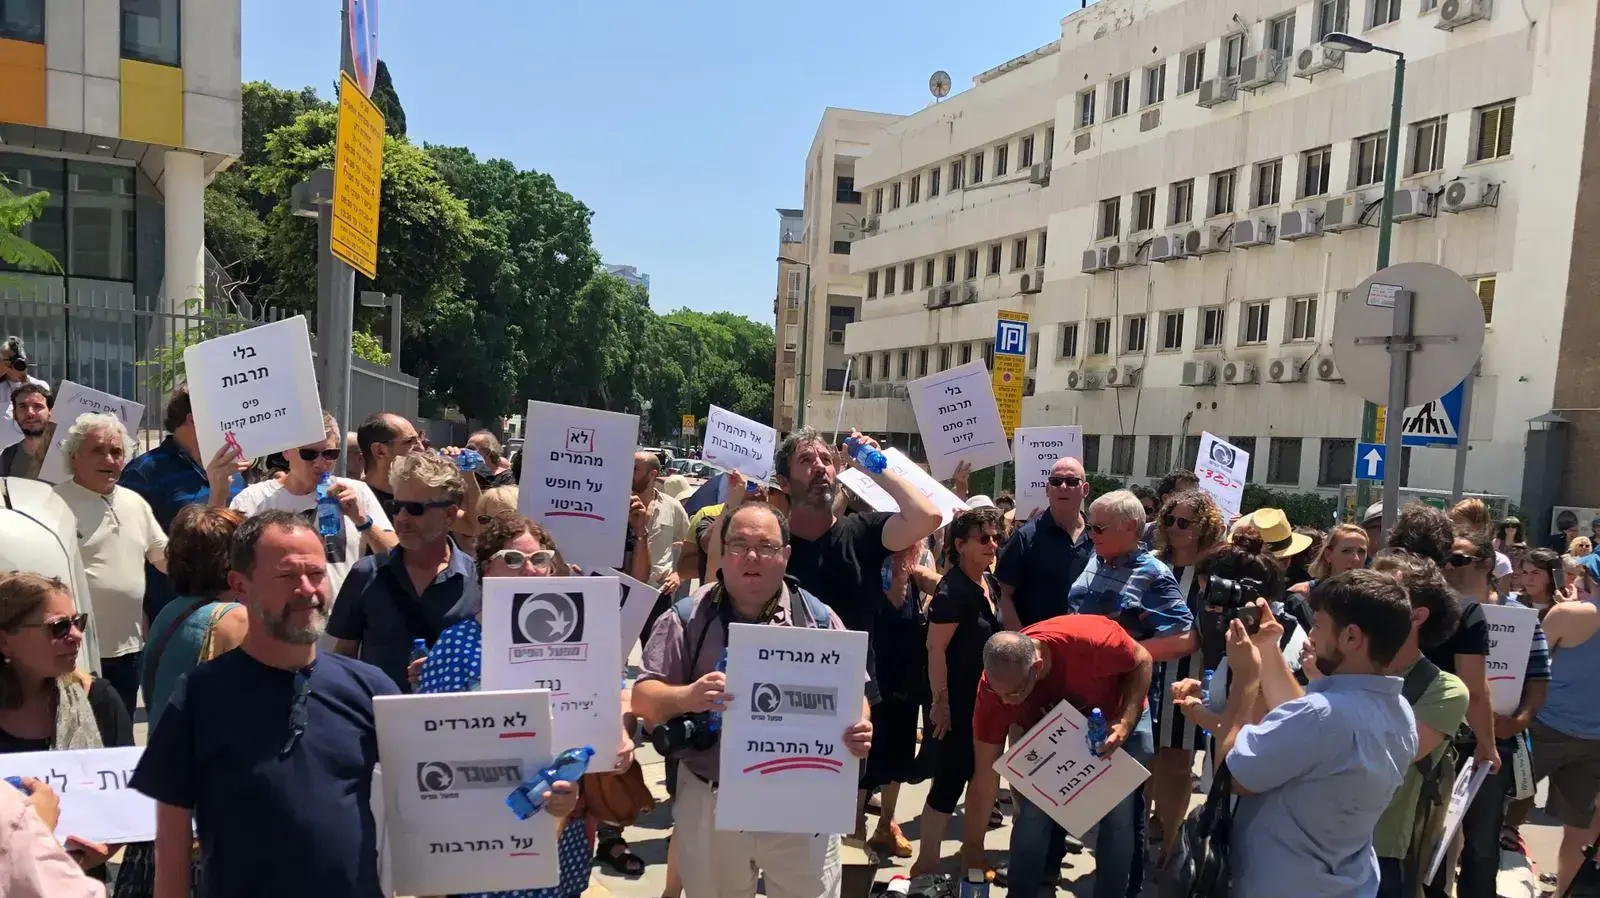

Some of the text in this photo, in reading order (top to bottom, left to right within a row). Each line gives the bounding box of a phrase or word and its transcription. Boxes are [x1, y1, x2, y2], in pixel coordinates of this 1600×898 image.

[232, 345, 257, 360] בלי
[222, 365, 269, 389] תרבות
[944, 385, 962, 395] בלי
[79, 397, 100, 409] תרצו
[242, 398, 260, 410] פיס
[939, 400, 972, 415] תרבות
[220, 408, 286, 431] זה סתם קזינו!
[943, 417, 977, 432] זה סתם
[570, 432, 588, 444] לא
[717, 421, 761, 444] אל תהמרו
[953, 433, 974, 444] קזינו
[711, 436, 762, 460] על התרבות
[550, 452, 603, 467] מהמרים
[546, 478, 603, 493] על חופש
[551, 499, 593, 512] הביטוי
[514, 646, 580, 657] מפעל הפיס
[758, 649, 840, 664] לא מגרדים
[534, 679, 561, 690] נגד
[783, 692, 835, 711] חישגד
[425, 712, 527, 731] לא מגרדים
[1048, 726, 1067, 744] אין
[747, 740, 834, 756] על התרבות
[456, 766, 521, 782] חישגד
[1057, 759, 1076, 774] בלי
[1059, 763, 1096, 796] תרבות
[430, 835, 533, 853] על התרבות
